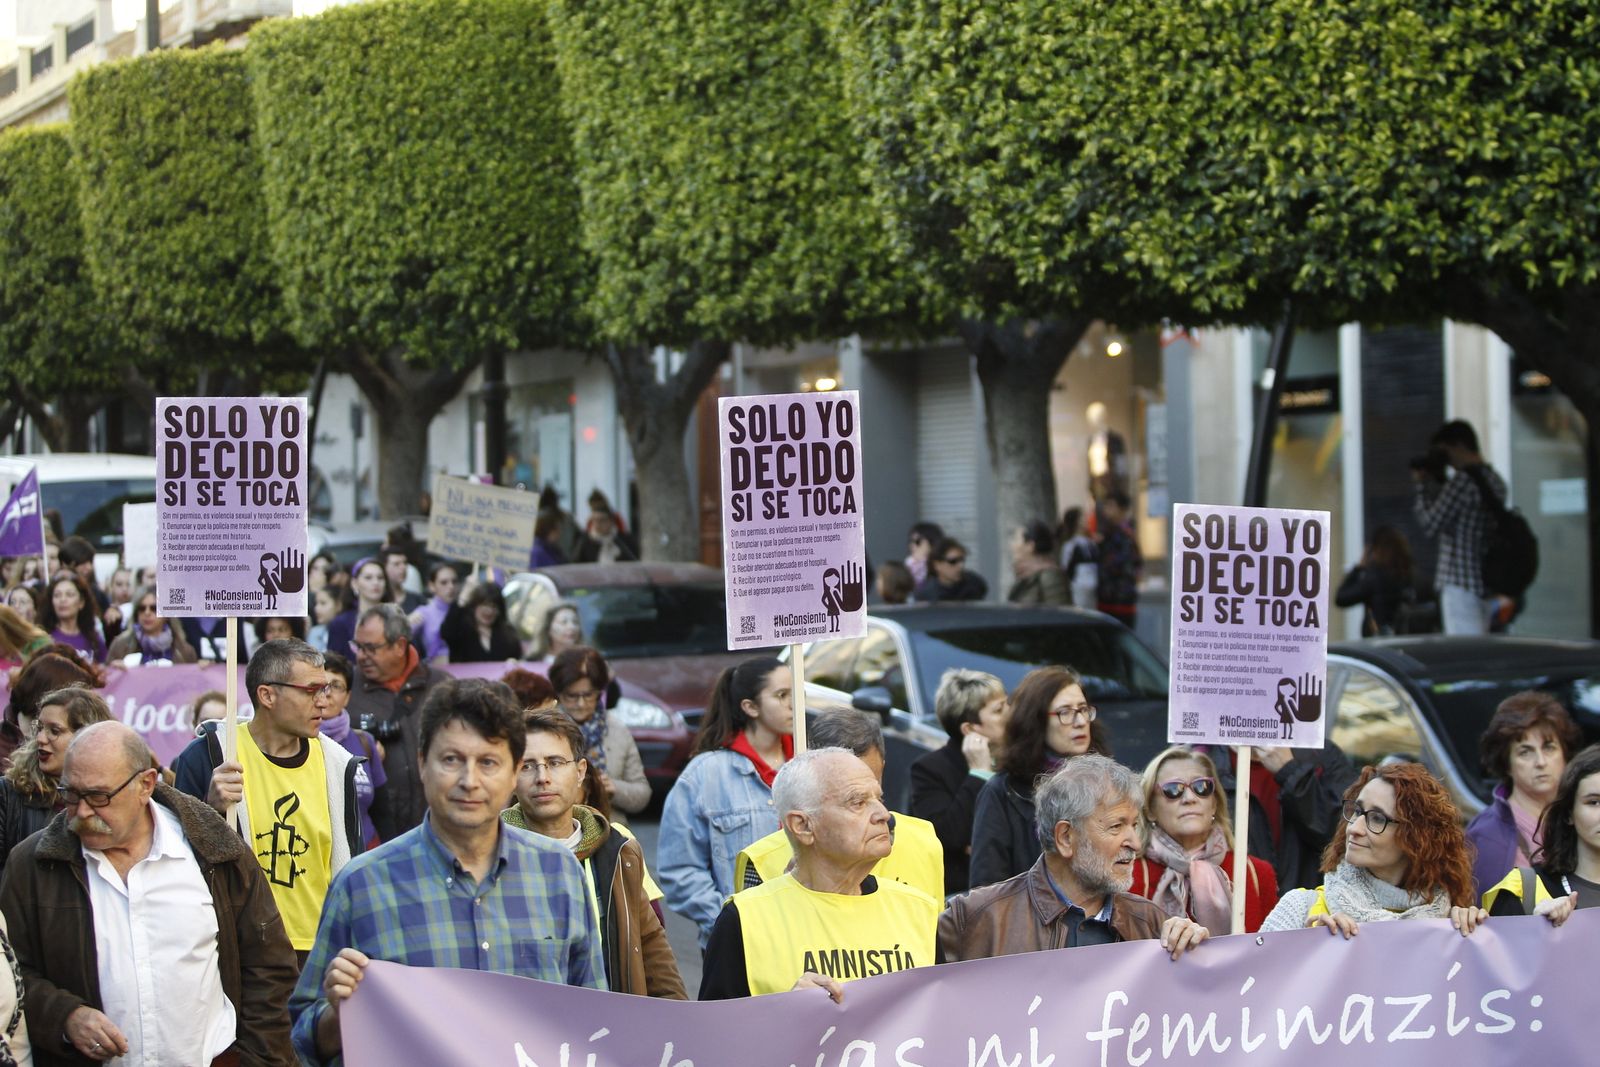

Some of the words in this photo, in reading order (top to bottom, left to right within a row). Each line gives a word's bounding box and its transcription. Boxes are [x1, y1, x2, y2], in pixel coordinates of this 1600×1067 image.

[165, 405, 247, 438] SOLO
[259, 405, 300, 438] YO
[728, 402, 805, 444] SOLO
[816, 400, 853, 438] YO
[165, 441, 300, 479] DECIDO
[731, 440, 855, 491] DECIDO
[164, 481, 186, 506] SI
[197, 481, 225, 506] SE
[236, 481, 300, 506] TOCA
[731, 493, 752, 522] SI
[762, 490, 789, 520] SE
[798, 486, 856, 517] TOCA
[258, 512, 272, 520] tengo
[731, 529, 739, 538] Sin
[740, 529, 746, 537] mi
[776, 525, 797, 534] violencia
[799, 523, 814, 532] sexual
[815, 524, 818, 532] y
[819, 522, 832, 532] tengo
[833, 520, 852, 529] derecho
[1183, 513, 1268, 552] SOLO
[1281, 518, 1321, 555] YO
[736, 540, 759, 549] Denunciar
[763, 540, 772, 548] que
[778, 537, 793, 547] policía
[802, 536, 813, 544] trate
[738, 553, 747, 561] Que
[763, 550, 786, 559] cuestione
[788, 549, 794, 557] mi
[738, 564, 753, 573] Recibir
[754, 563, 774, 572] atención
[775, 561, 797, 570] adecuada
[804, 560, 808, 568] el
[1182, 551, 1320, 598] DECIDO
[739, 576, 756, 585] Recibir
[757, 576, 771, 585] apoyo
[205, 590, 262, 600] #NoConsiento
[739, 589, 748, 597] Que
[748, 589, 752, 597] el
[753, 588, 771, 597] agresor
[772, 587, 786, 596] pague
[1181, 595, 1203, 622] SI
[1215, 597, 1244, 624] SE
[1256, 599, 1319, 628] TOCA
[774, 613, 826, 627] #NoConsiento
[774, 629, 779, 639] la
[781, 627, 806, 638] violencia
[808, 625, 826, 635] sexual
[1220, 716, 1278, 728] #NoConsiento
[1219, 729, 1225, 737] la
[1226, 729, 1255, 738] violencia
[1257, 730, 1278, 739] sexual
[803, 944, 916, 979] AMNISTÍA
